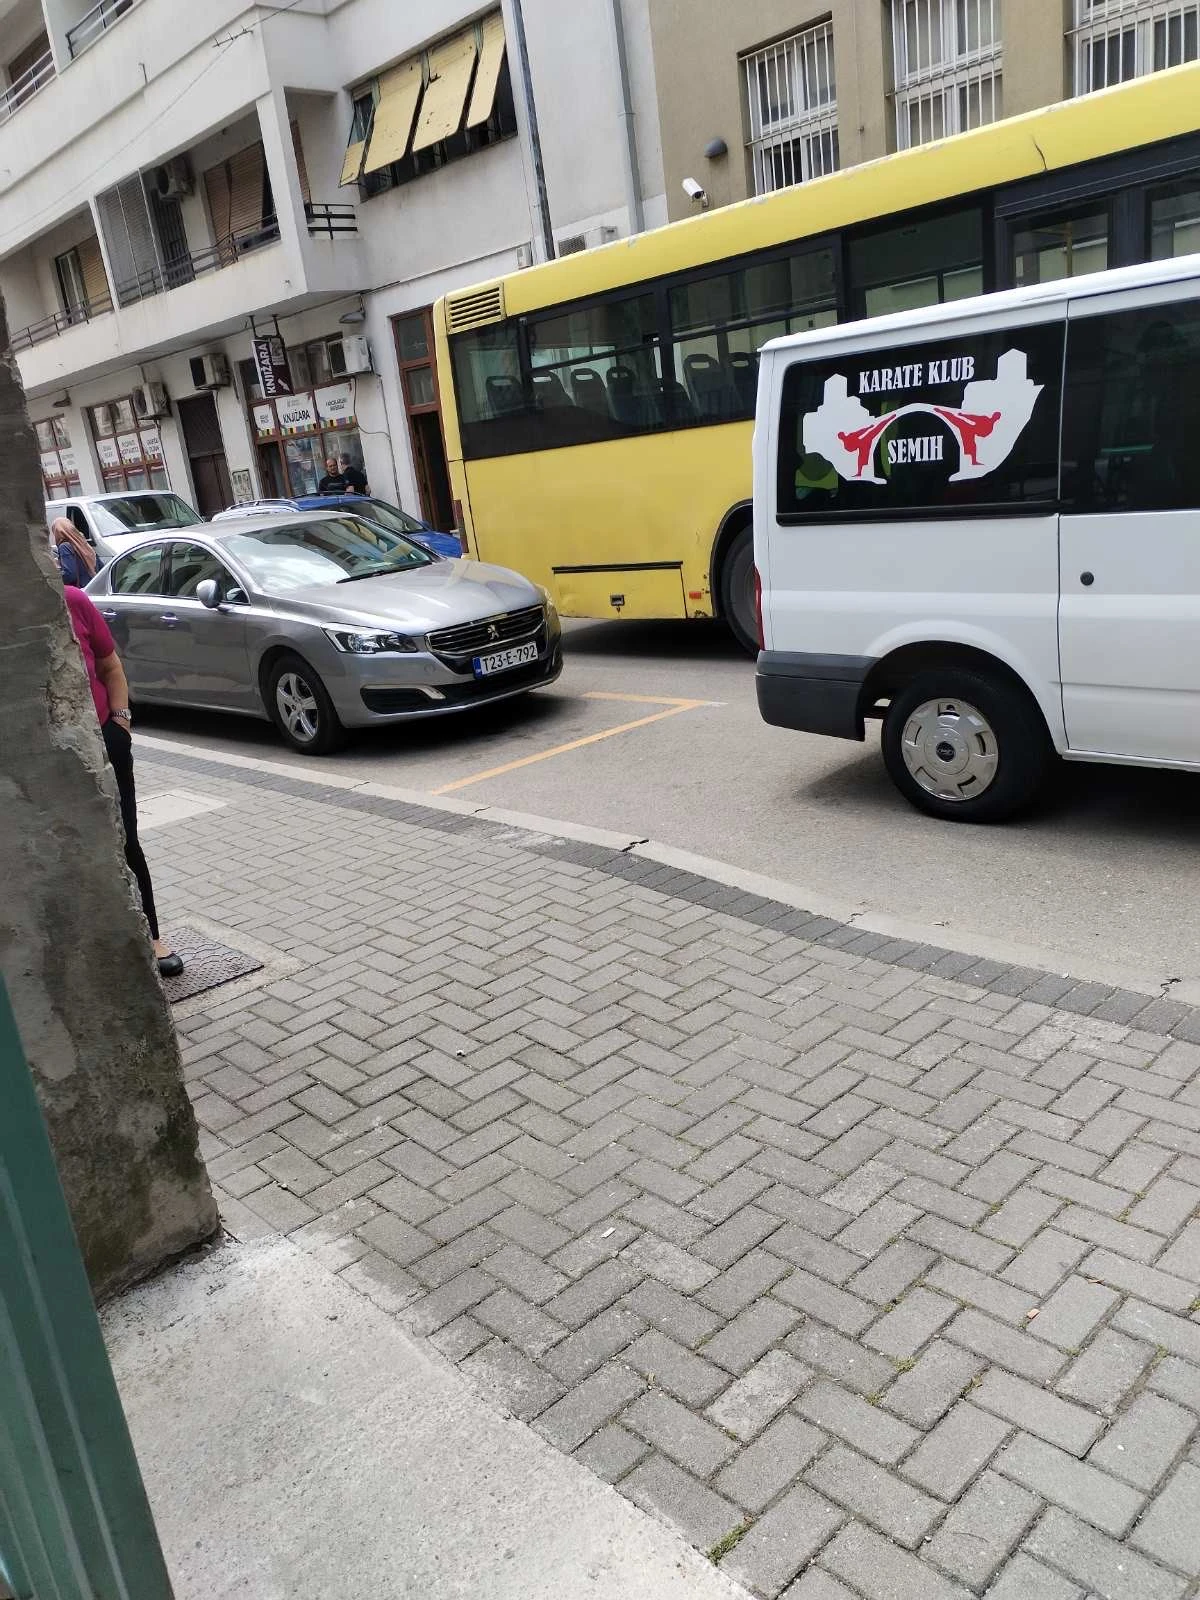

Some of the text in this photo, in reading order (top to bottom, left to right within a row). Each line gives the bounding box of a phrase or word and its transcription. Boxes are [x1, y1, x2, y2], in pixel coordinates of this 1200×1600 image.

[258, 343, 277, 394] KNJIŽARA
[859, 356, 975, 394] KARATE KLUB
[887, 435, 944, 464] SEMIH
[482, 644, 537, 672] T23-E-792
